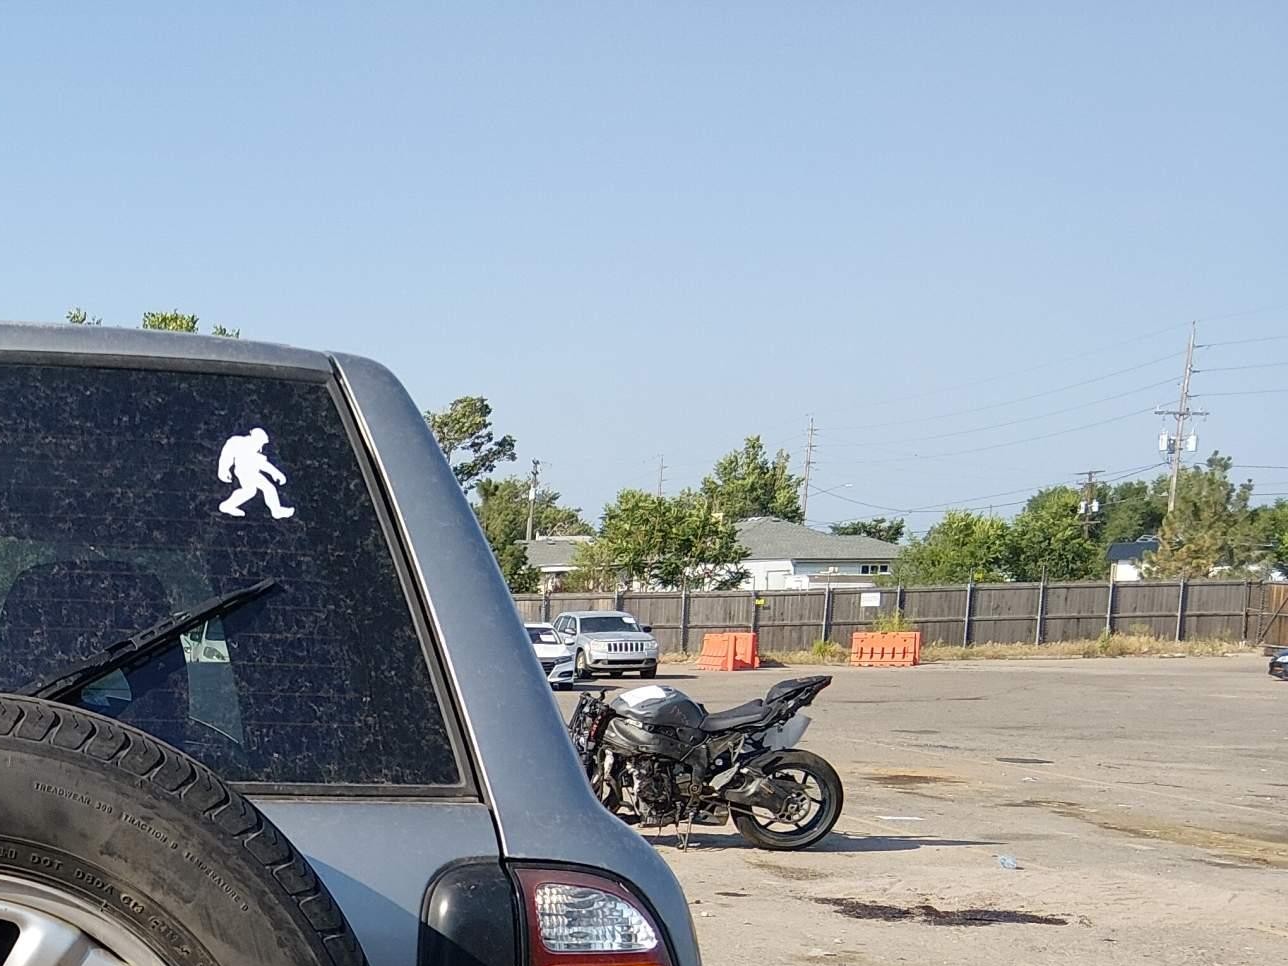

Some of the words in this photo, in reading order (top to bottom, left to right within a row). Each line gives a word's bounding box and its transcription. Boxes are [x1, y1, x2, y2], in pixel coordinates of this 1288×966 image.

[30, 853, 63, 872] DOT
[34, 782, 91, 805] TREADWEAR
[123, 813, 168, 842] TRACTION
[183, 851, 240, 902] TEMPERATURE
